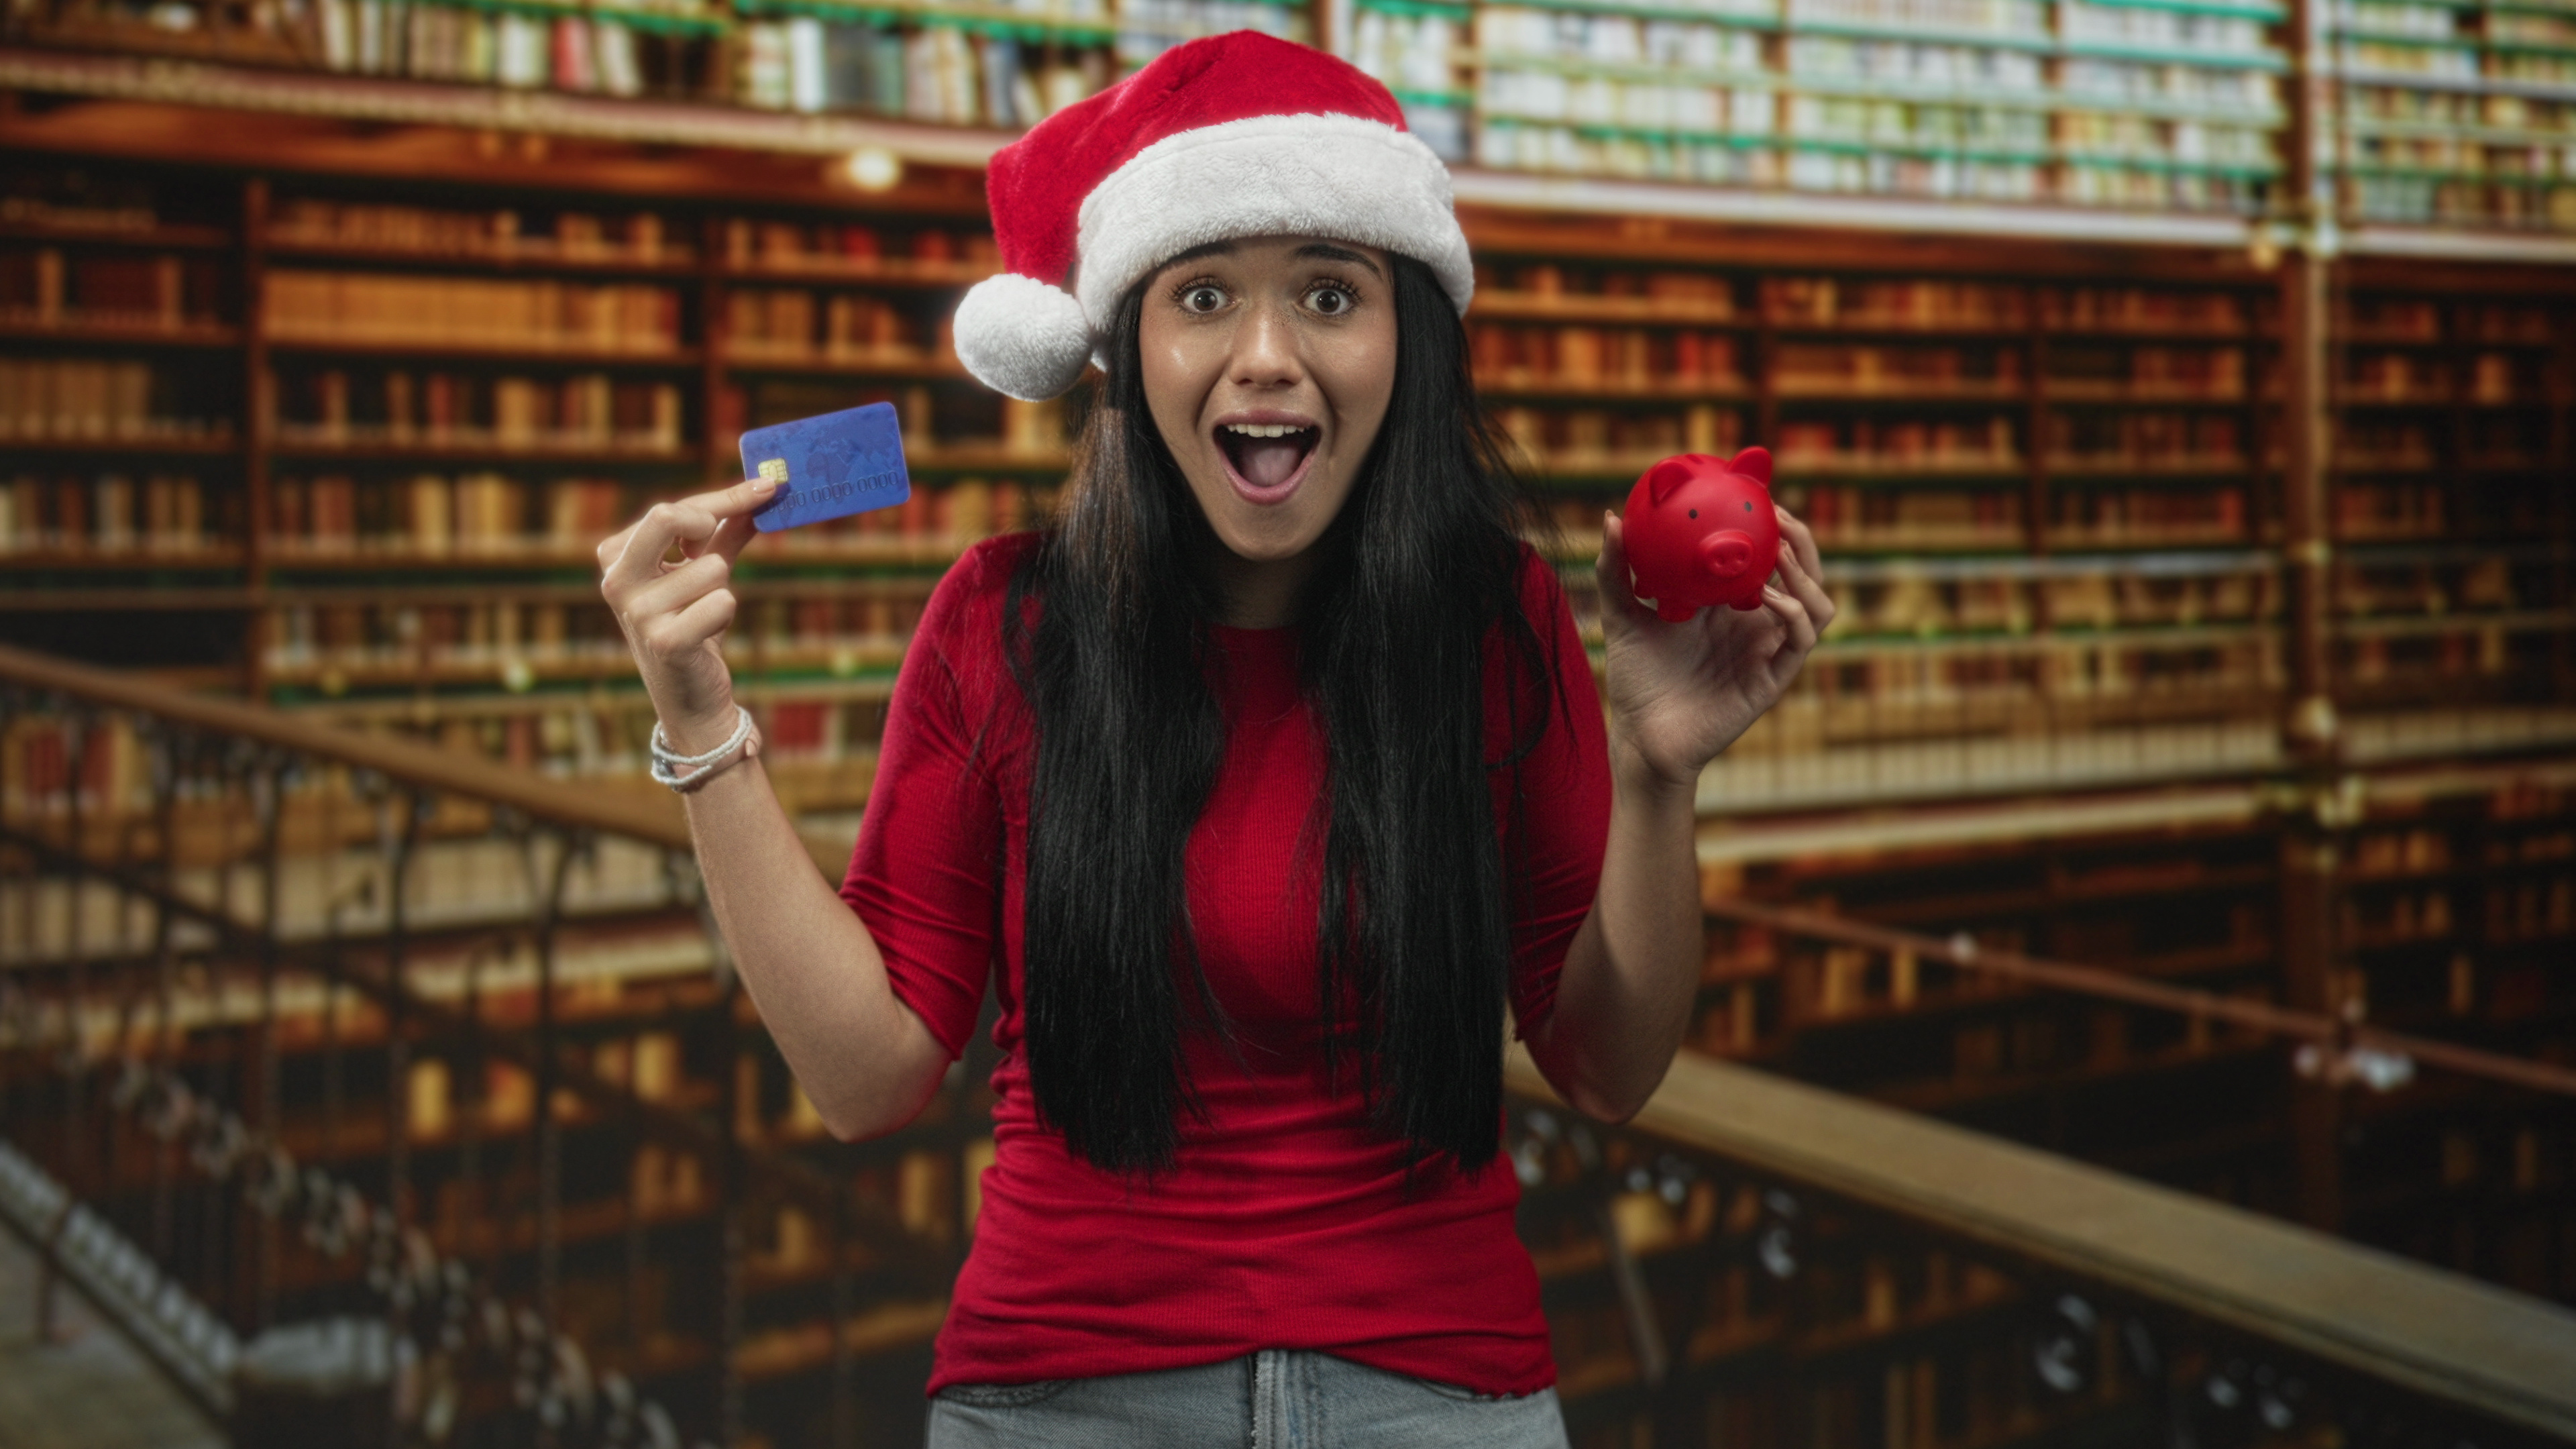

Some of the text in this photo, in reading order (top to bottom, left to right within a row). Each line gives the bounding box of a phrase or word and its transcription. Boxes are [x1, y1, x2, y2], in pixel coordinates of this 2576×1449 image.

[767, 470, 899, 513] 000 0000 0000
